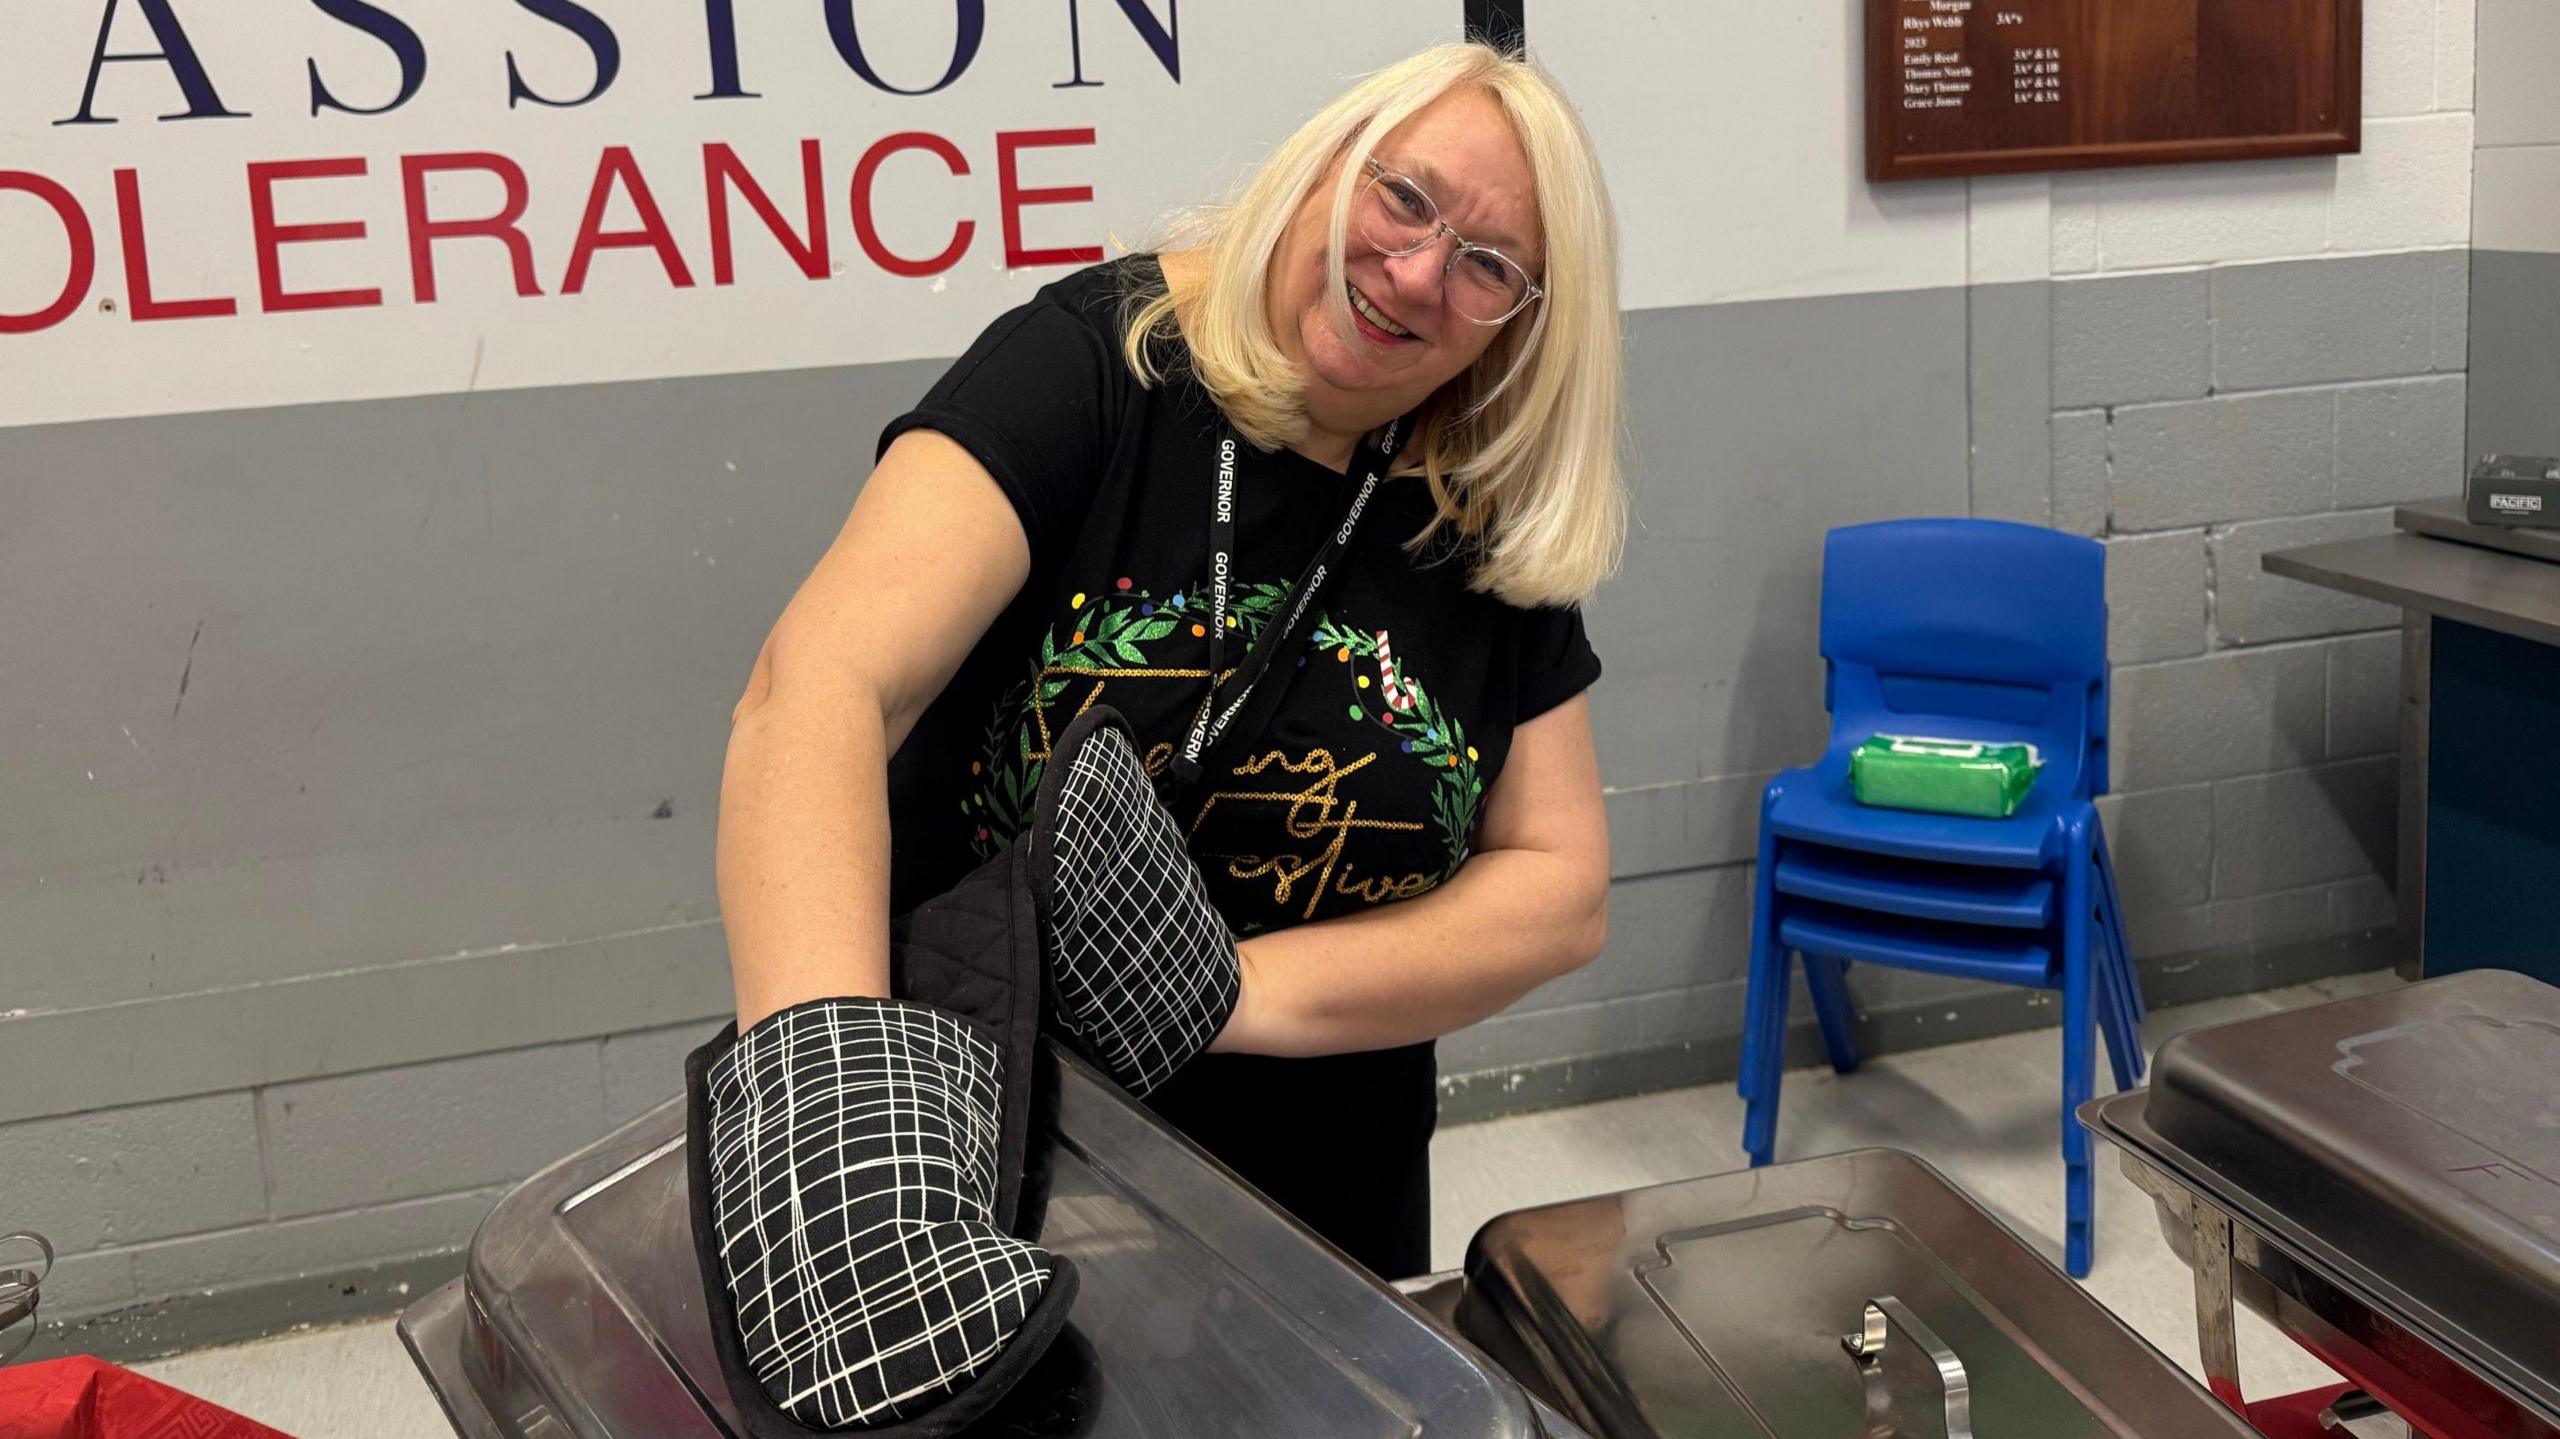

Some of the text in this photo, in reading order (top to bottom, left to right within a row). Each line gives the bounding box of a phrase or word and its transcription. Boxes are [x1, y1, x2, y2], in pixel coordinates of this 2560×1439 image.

[1930, 0, 1972, 13] Morgan
[1903, 16, 1931, 31] Rhys
[1932, 15, 1964, 28] Webb
[1904, 53, 1932, 67] Emily
[1934, 52, 1960, 64] Reed
[2034, 48, 2044, 60] &
[1905, 68, 1943, 79] Thomas
[1944, 66, 1974, 77] North
[2034, 62, 2044, 74] &
[1904, 82, 1931, 96] Mary
[1934, 81, 1971, 93] Thomas
[2034, 77, 2044, 89] &
[1903, 98, 1934, 109] Grace
[1935, 96, 1963, 107] Jones
[2034, 91, 2045, 103] &
[0, 126, 1105, 335] OLERANCE
[1381, 416, 1399, 455] GOVE
[1216, 439, 1236, 524] GOVERNOR
[1336, 471, 1379, 546] GOVERNOR
[2493, 495, 2541, 510] PACIFIC
[1213, 551, 1229, 641] GOVERNOR
